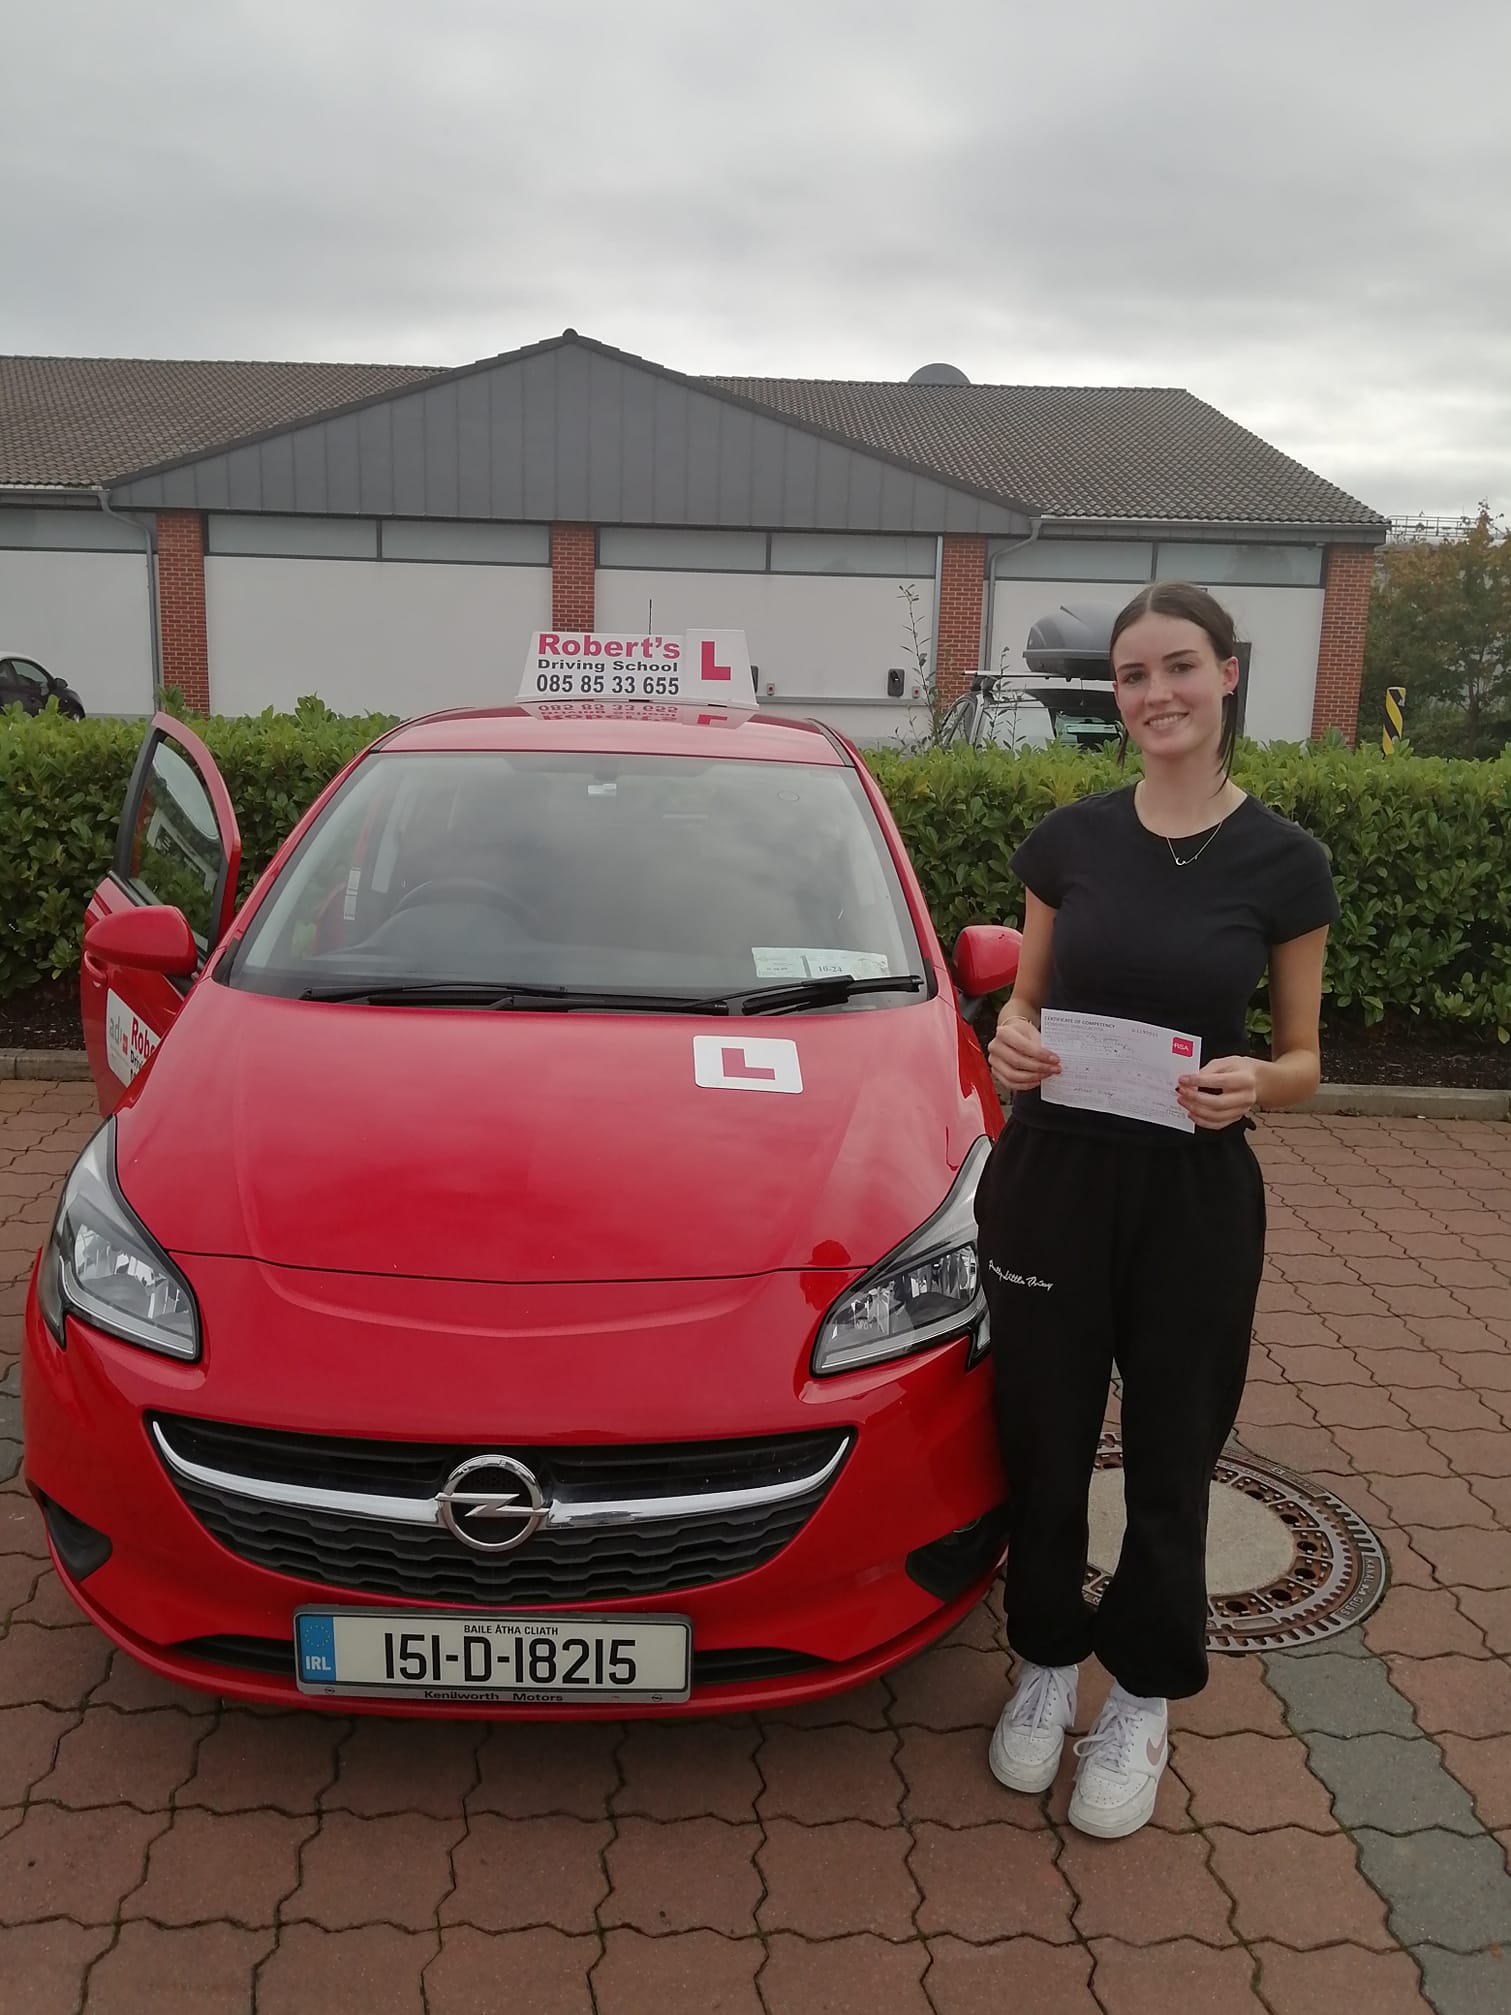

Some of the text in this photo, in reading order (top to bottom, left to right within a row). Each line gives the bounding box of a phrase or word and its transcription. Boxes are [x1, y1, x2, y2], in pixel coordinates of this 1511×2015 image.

[538, 634, 680, 659] Robert's
[537, 659, 678, 673] Driving School
[701, 641, 731, 680] L
[536, 674, 679, 695] 085 85 33 655
[1174, 1042, 1189, 1051] RSA
[722, 1048, 775, 1080] L
[464, 1624, 492, 1634] BAILE
[524, 1626, 558, 1636] CLIATH
[306, 1655, 331, 1671] IRL
[384, 1632, 636, 1685] 151-D-18215
[424, 1690, 564, 1701] Kenilworth Motors
